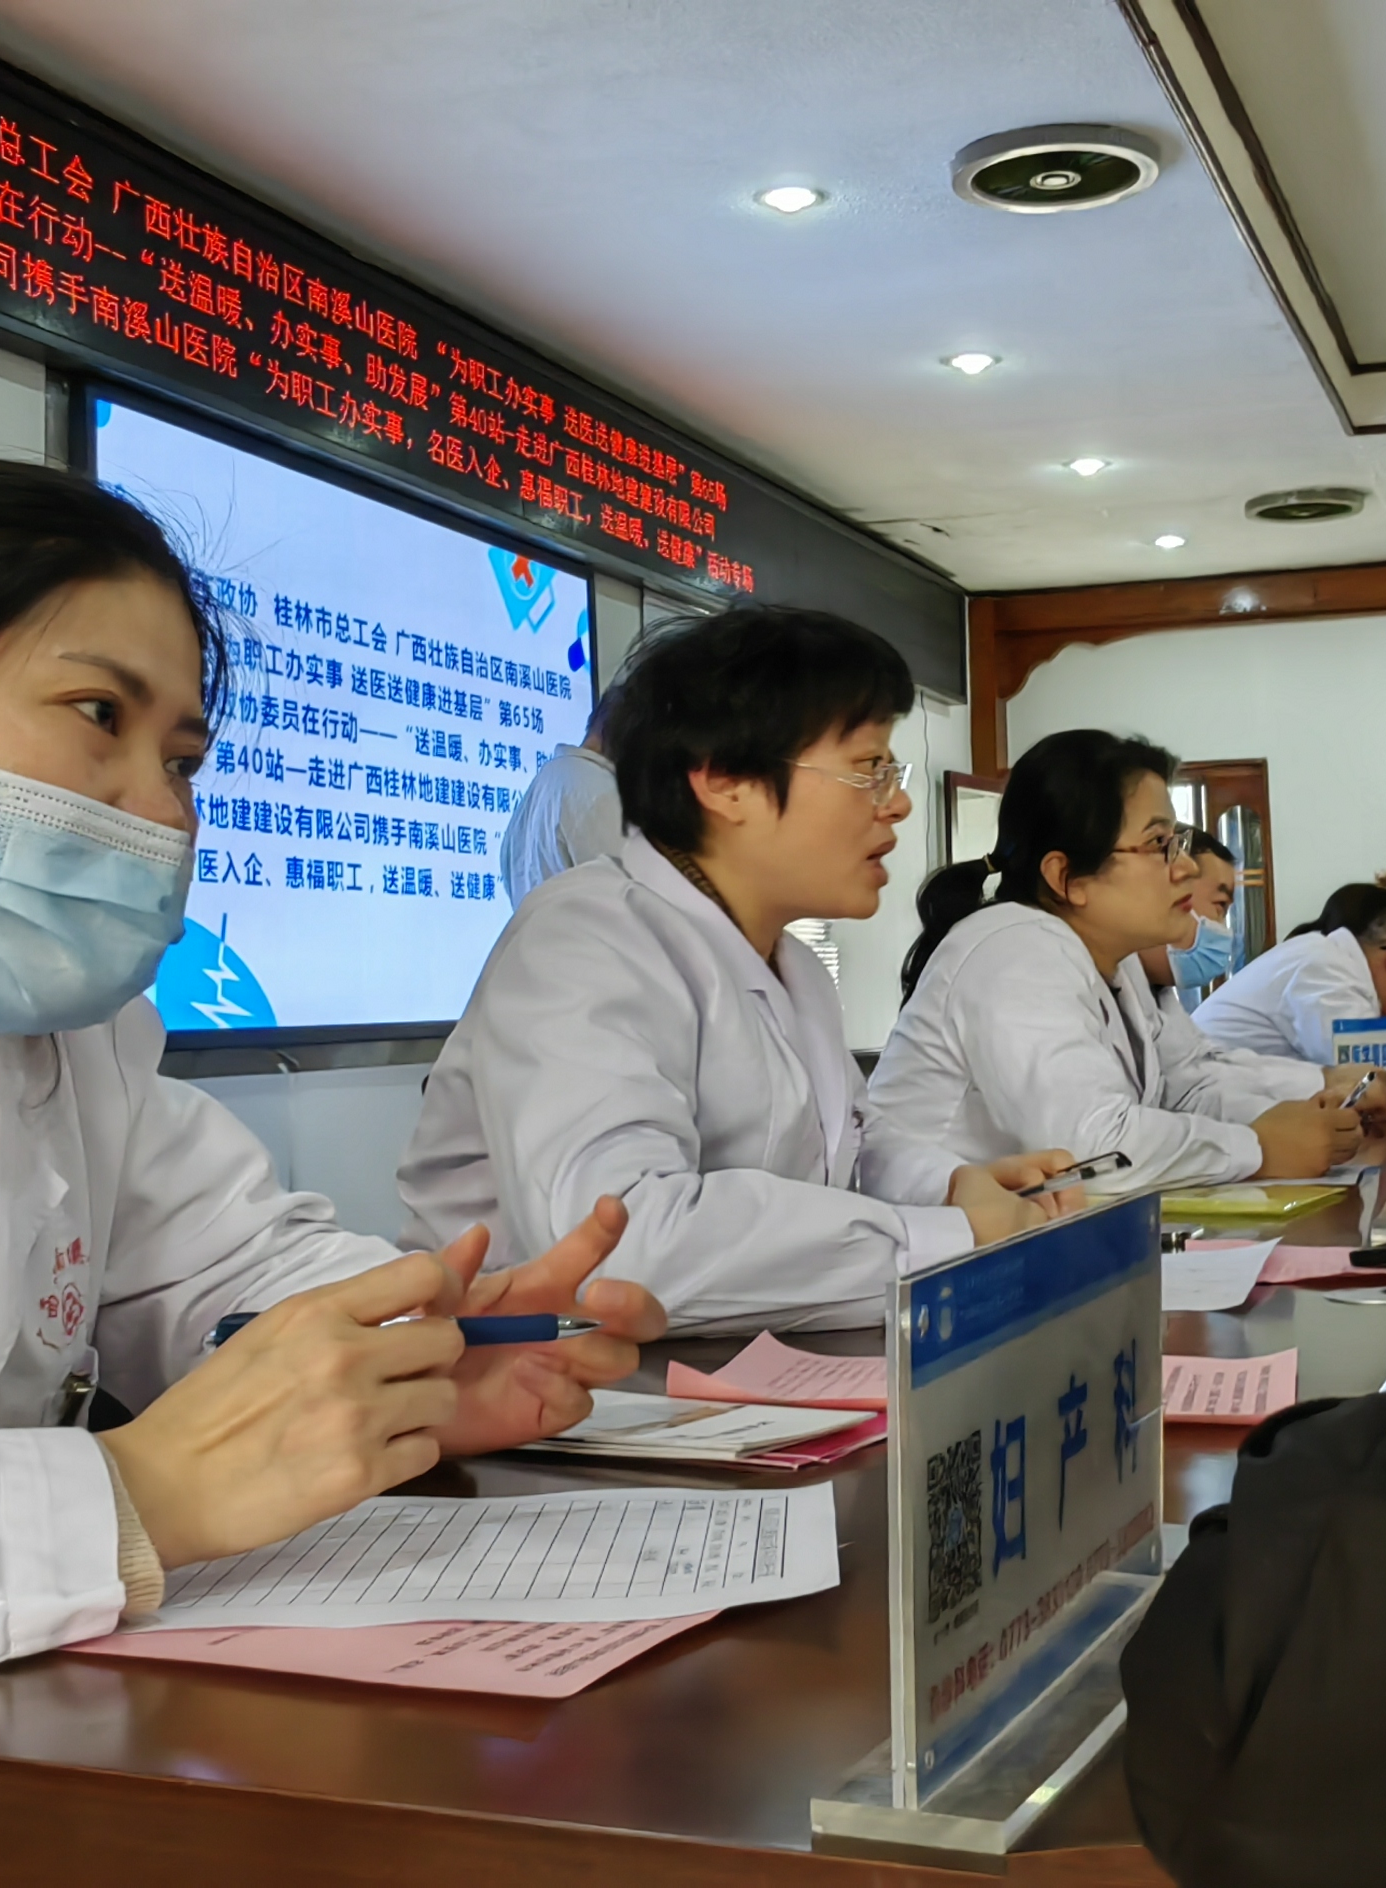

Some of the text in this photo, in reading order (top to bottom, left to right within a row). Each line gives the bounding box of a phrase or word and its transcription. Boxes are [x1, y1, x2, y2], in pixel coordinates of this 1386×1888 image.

[112, 180, 418, 360] 广西壮族自治区南溪山医院
[273, 593, 387, 654] 桂林市总工会
[396, 629, 572, 700] 广西壮族自治区南溪山医院
